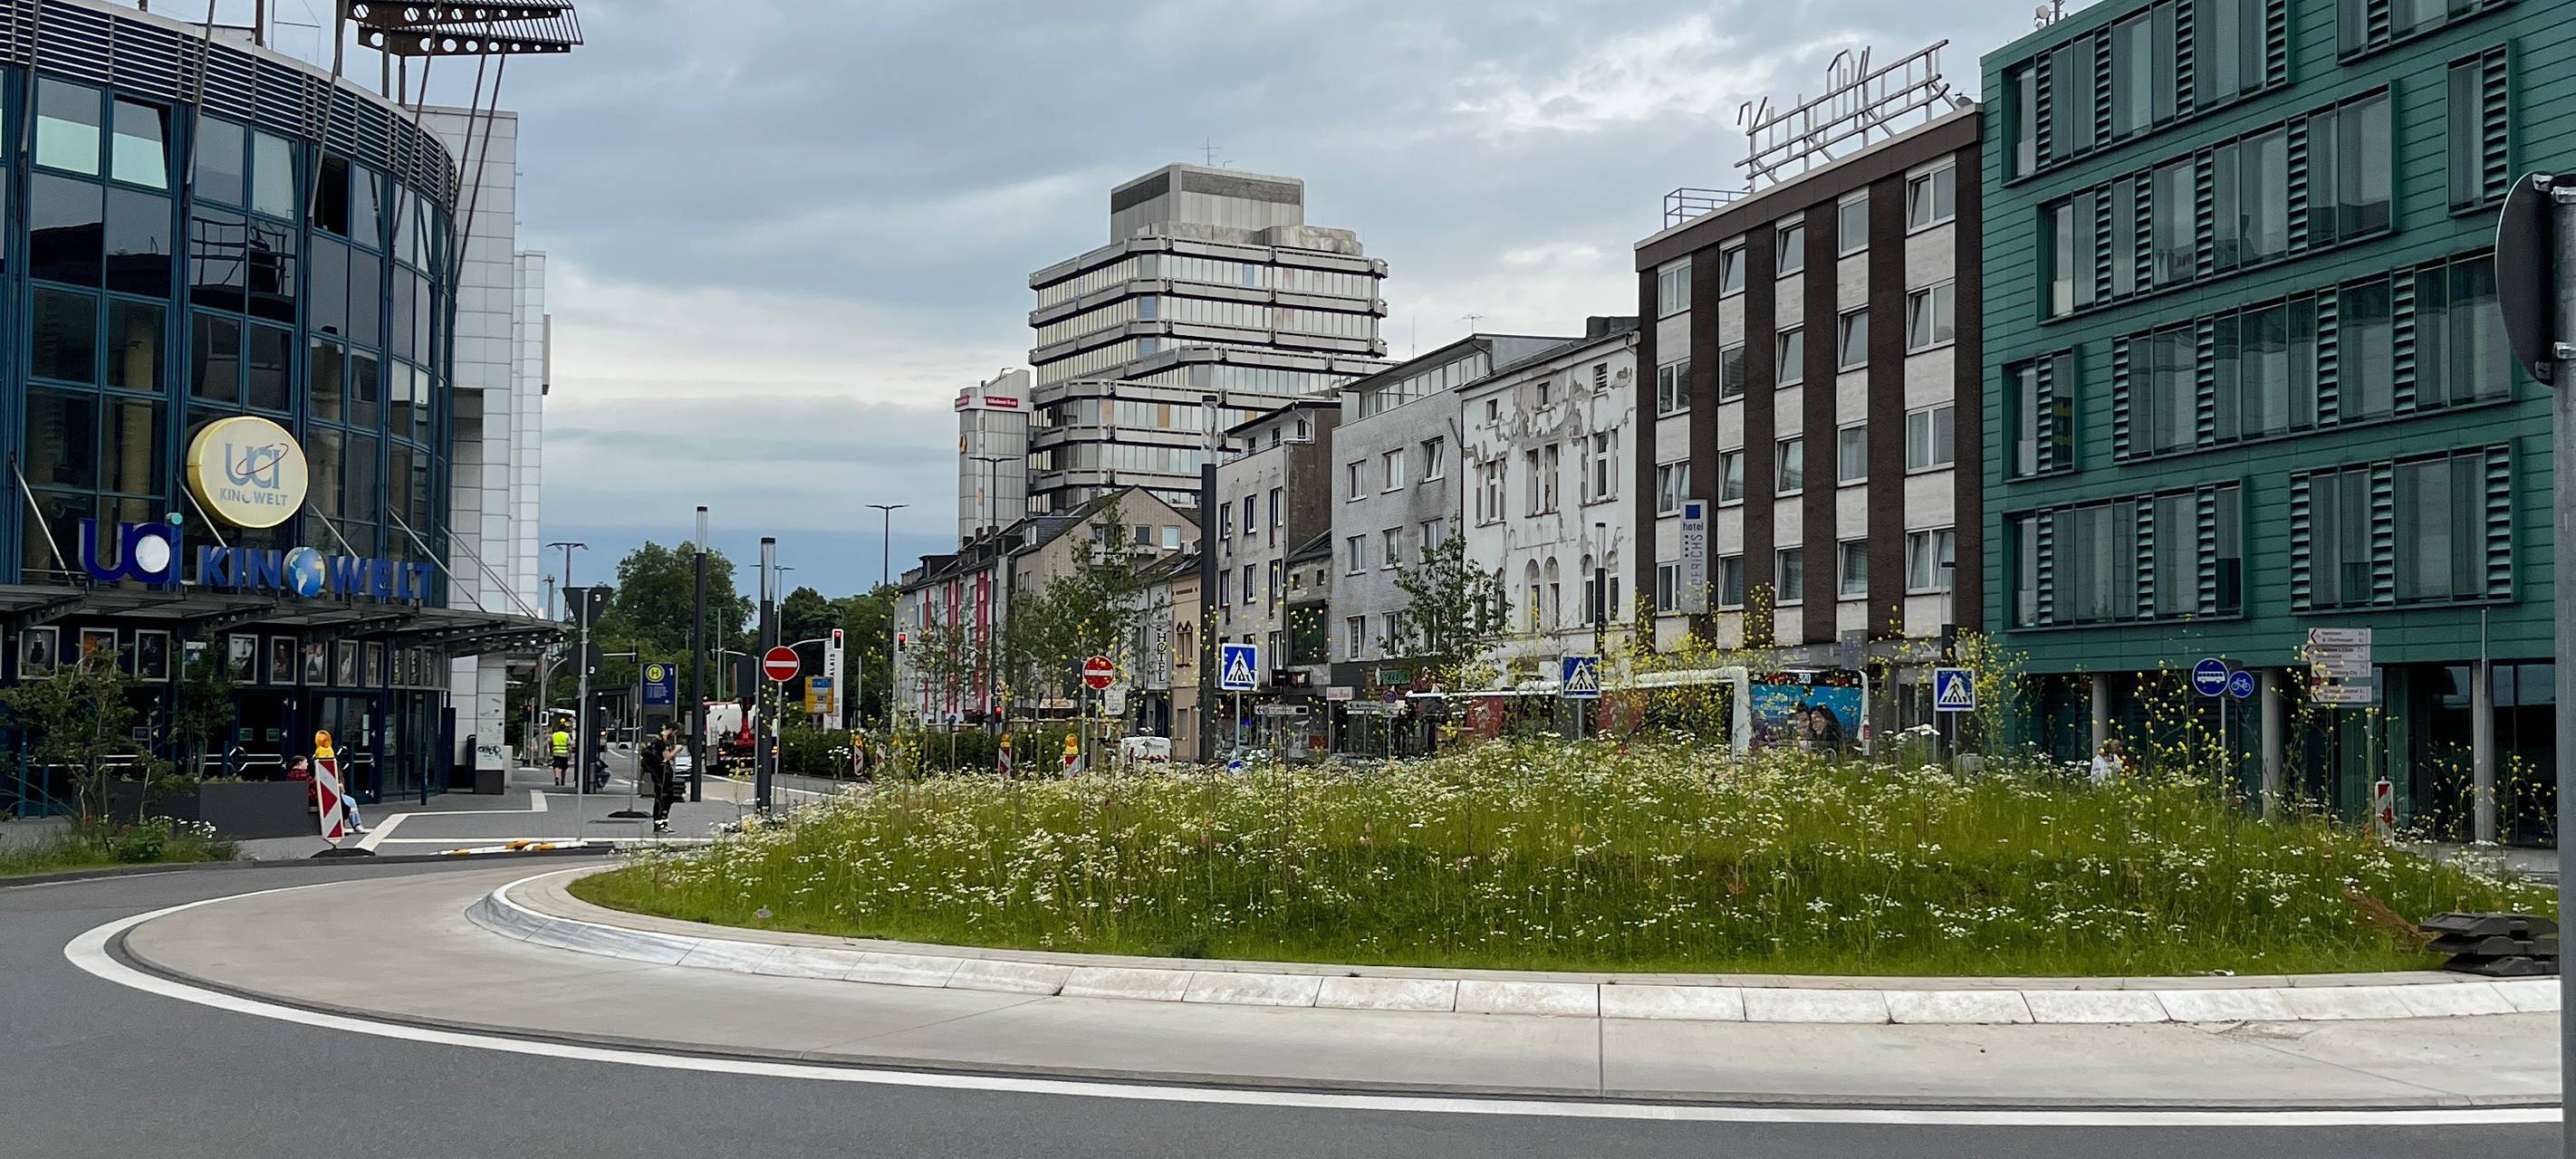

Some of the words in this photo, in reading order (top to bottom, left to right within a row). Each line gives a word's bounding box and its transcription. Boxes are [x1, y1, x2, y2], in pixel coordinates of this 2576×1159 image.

[225, 443, 282, 490] UCI
[1683, 522, 1704, 532] hotel
[1157, 632, 1167, 682] HOTEL
